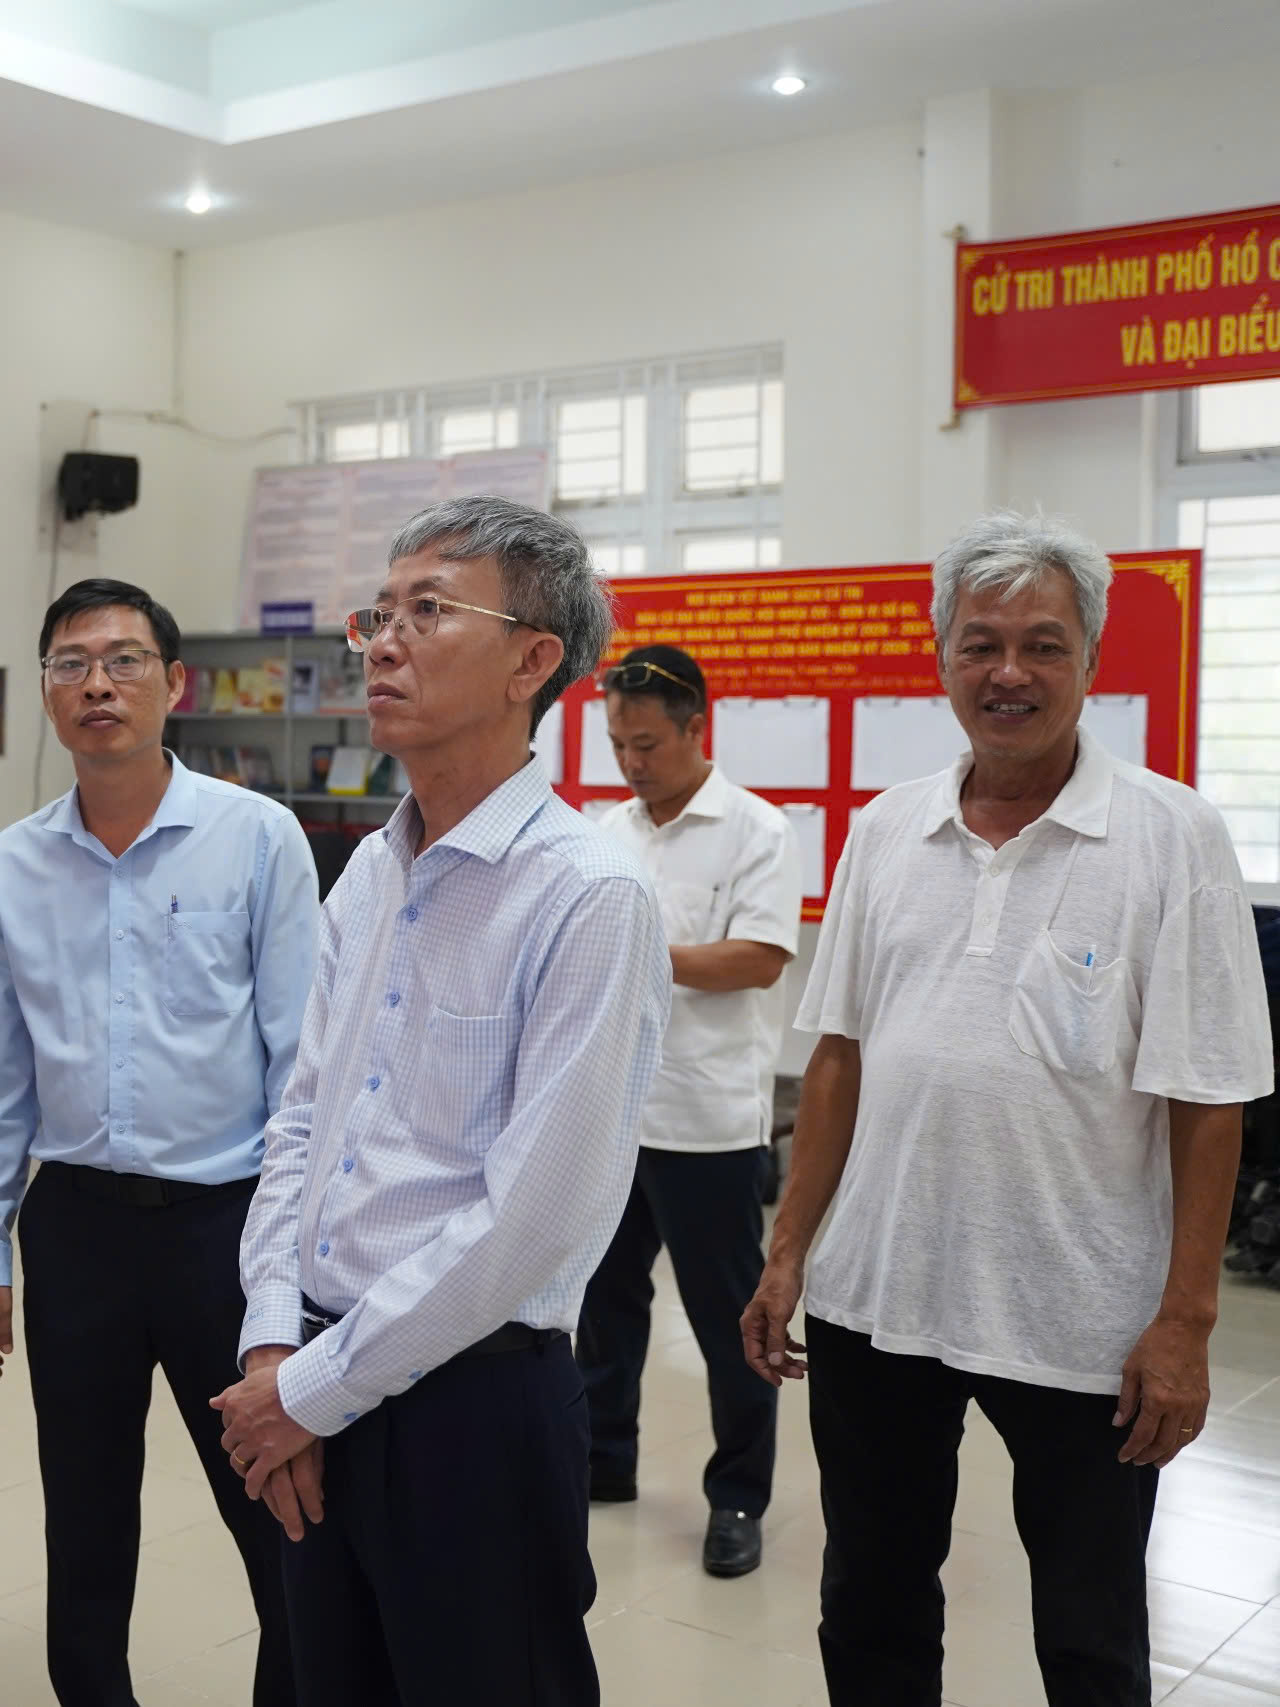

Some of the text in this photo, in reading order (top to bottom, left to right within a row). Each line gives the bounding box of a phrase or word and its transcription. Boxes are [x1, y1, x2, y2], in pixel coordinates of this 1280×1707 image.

[973, 261, 1010, 315] CỬ
[1015, 268, 1054, 312] TRI
[1061, 254, 1149, 306] THÀNH
[1155, 233, 1215, 295] PHỐ
[1121, 315, 1156, 367] VÀ
[1163, 316, 1211, 369] ĐẠI
